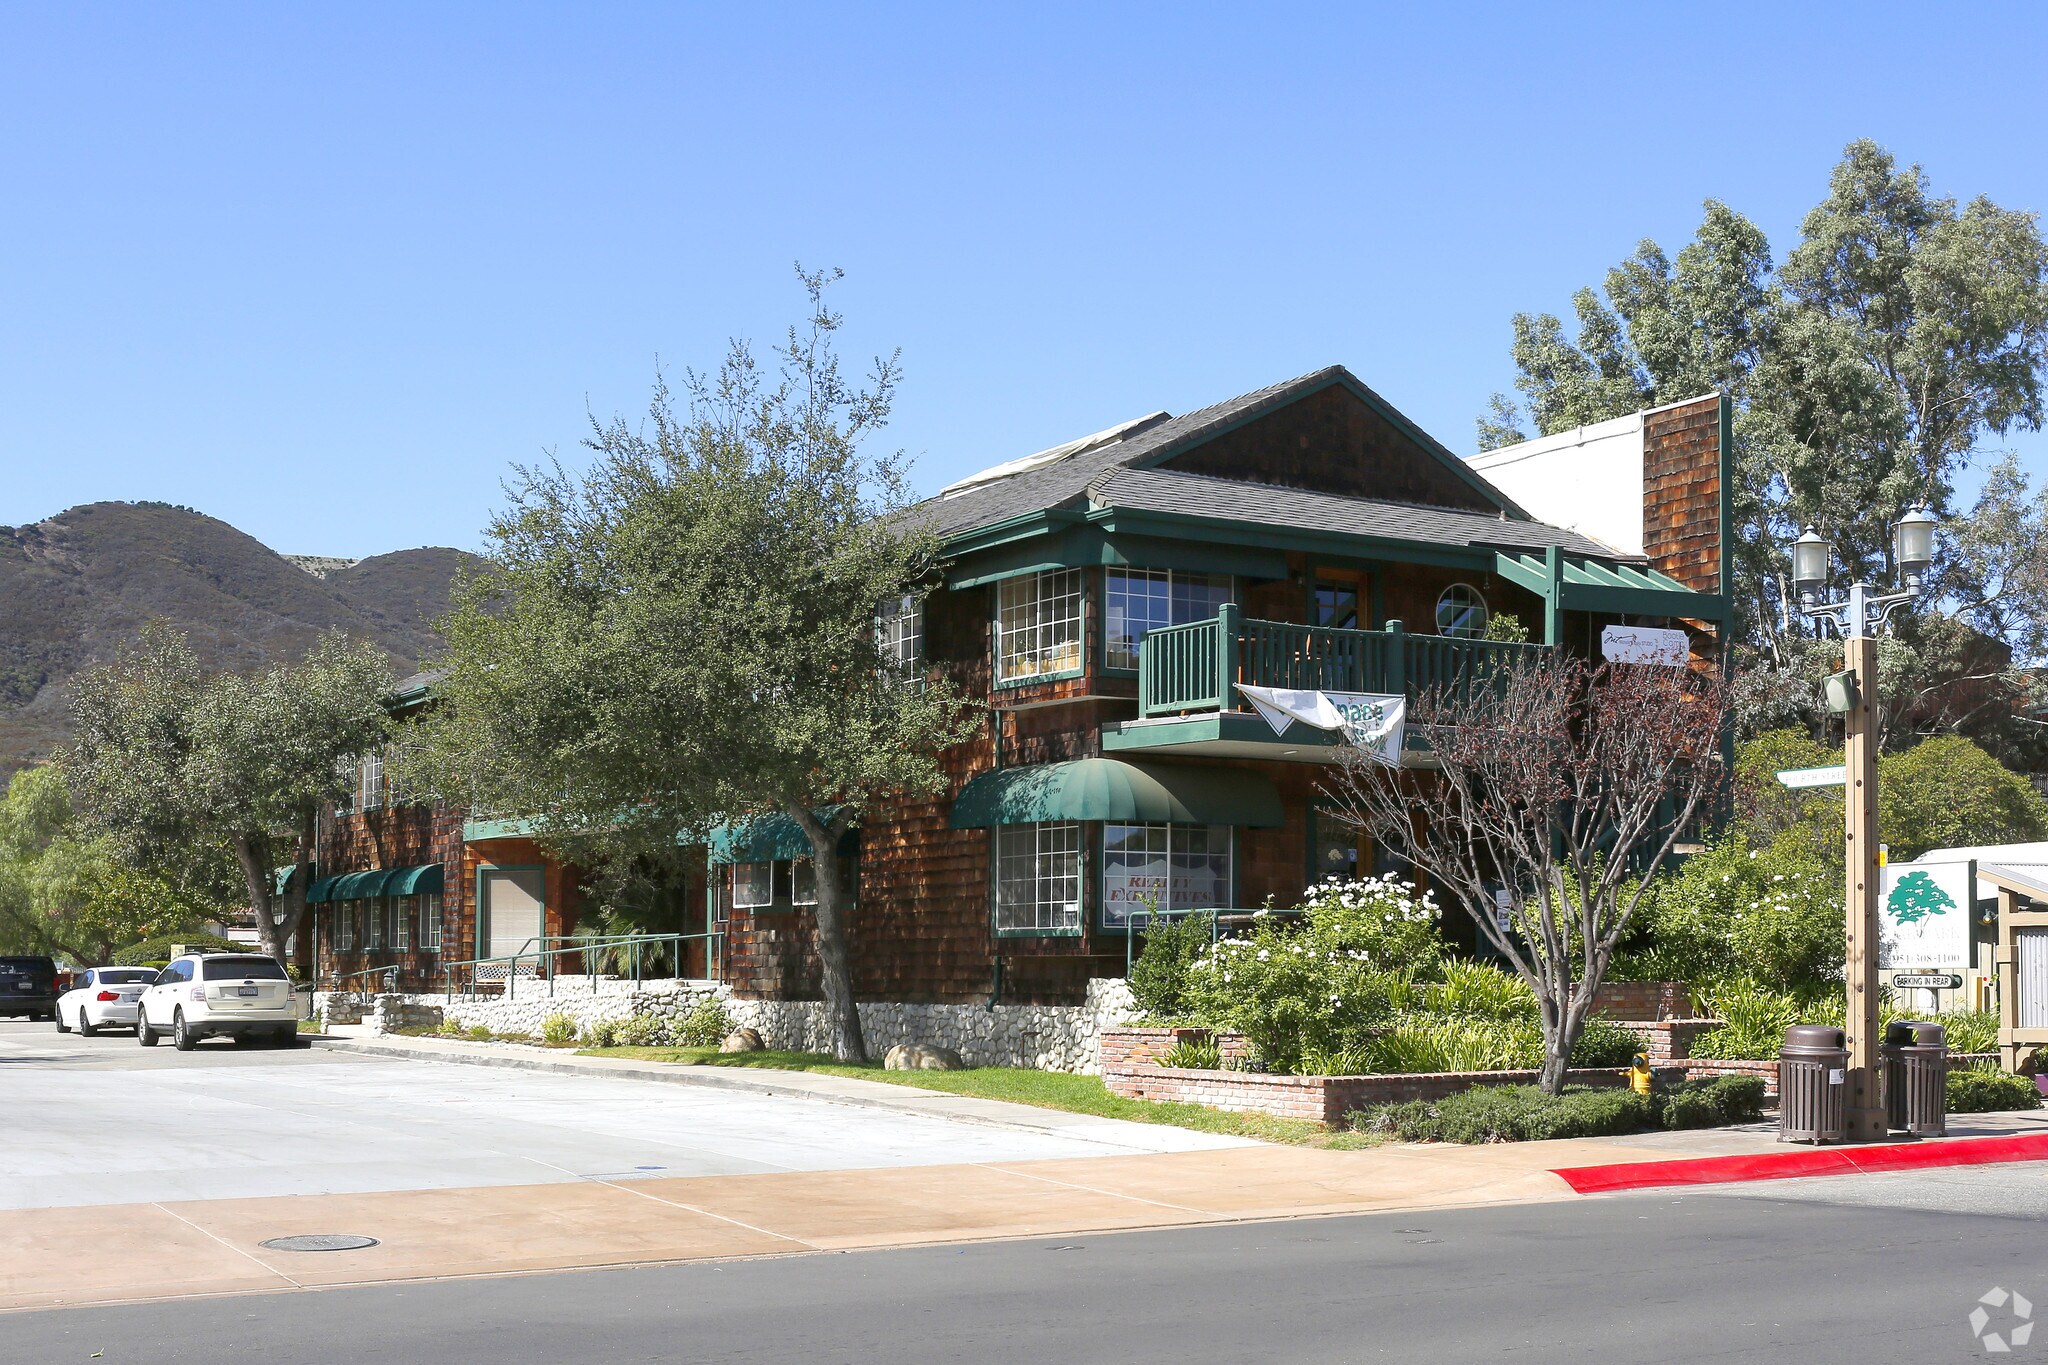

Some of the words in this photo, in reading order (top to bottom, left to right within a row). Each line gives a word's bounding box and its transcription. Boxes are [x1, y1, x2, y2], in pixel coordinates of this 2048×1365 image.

[1821, 770, 1846, 781] STREE
[1129, 875, 1192, 888] REALTY
[1896, 977, 1923, 986] PARKING
[1924, 977, 1931, 986] IN
[1932, 977, 1949, 986] REAR
